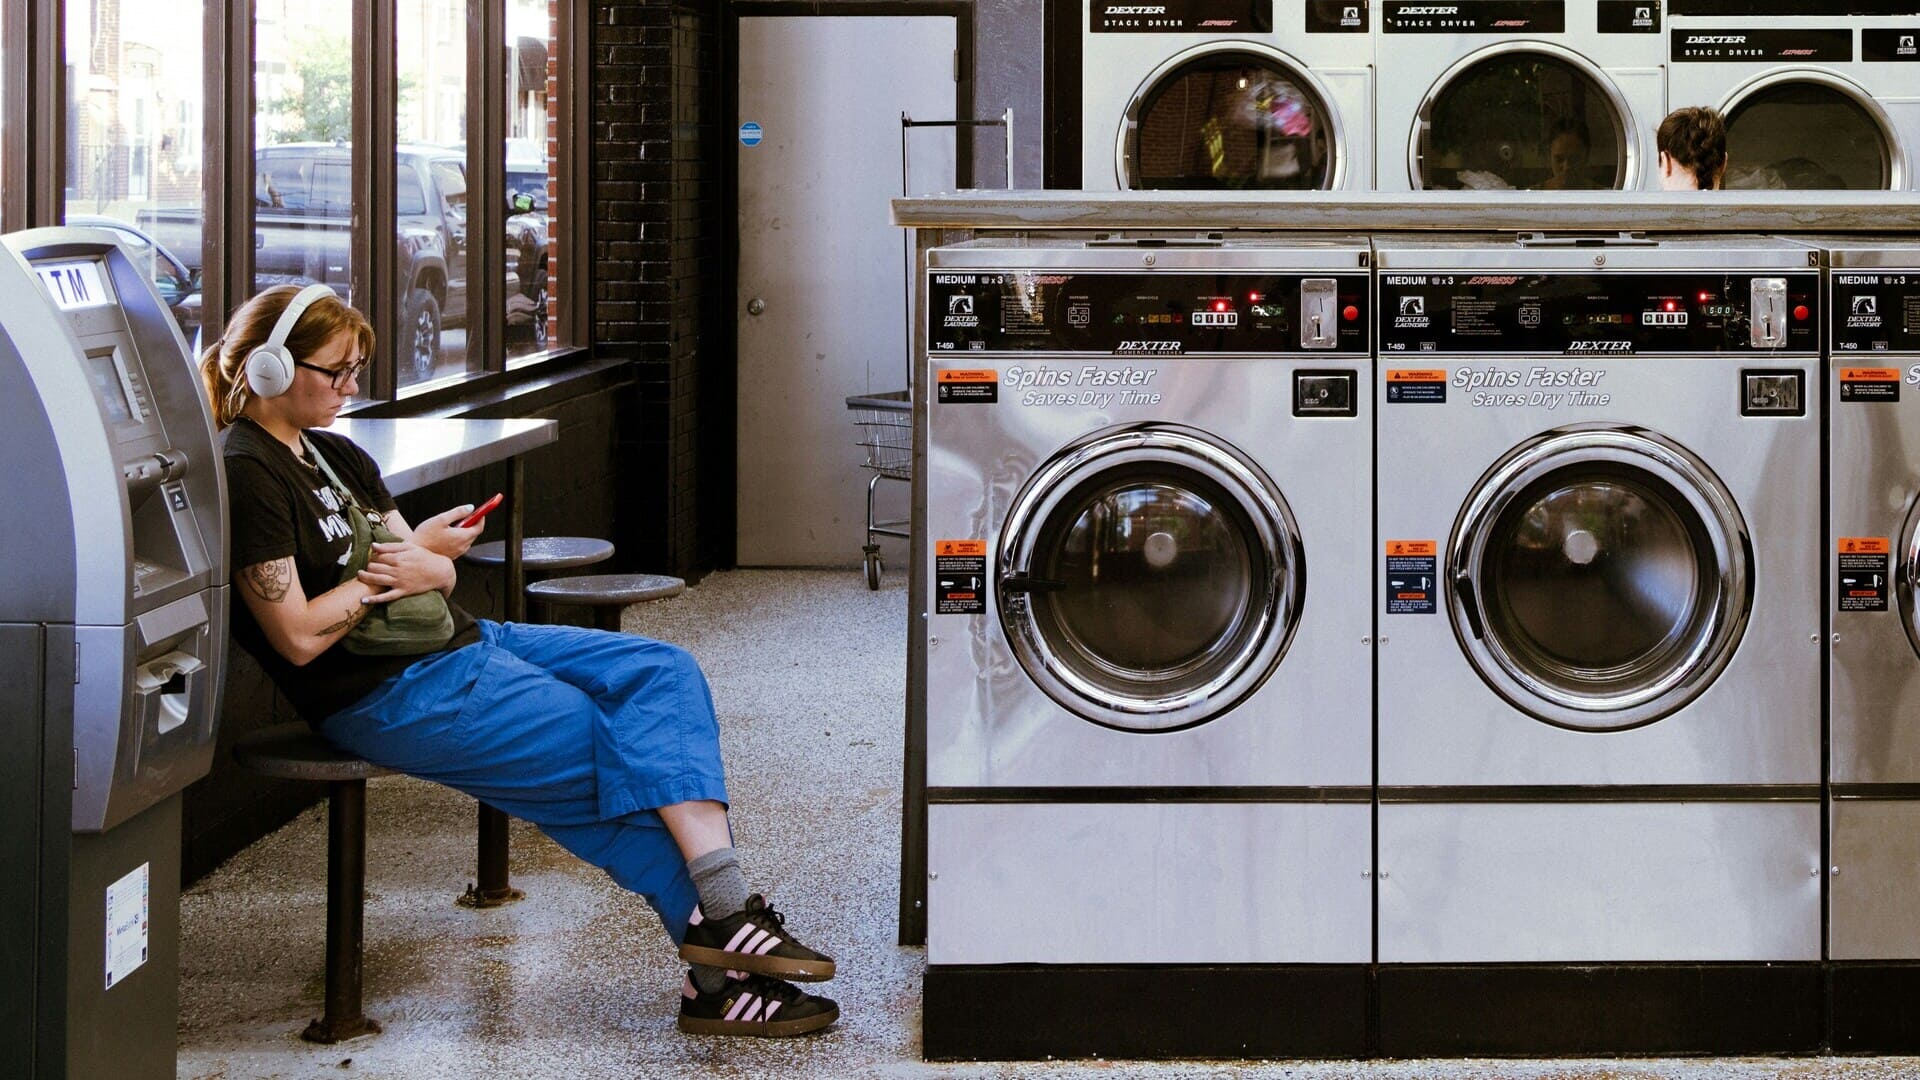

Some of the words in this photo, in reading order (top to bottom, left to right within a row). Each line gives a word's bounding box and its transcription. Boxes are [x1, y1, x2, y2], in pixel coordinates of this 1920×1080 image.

[1104, 6, 1166, 15] DEXTER
[1397, 6, 1459, 15] DEXTER
[1104, 20, 1140, 28] STACK
[1148, 20, 1184, 28] DRYER
[1396, 20, 1433, 28] STACK
[1440, 20, 1476, 28] DRYER
[1685, 35, 1747, 44] DEXTER
[1361, 253, 1368, 266] 7
[1809, 252, 1817, 266] 8
[936, 275, 976, 285] MEDIUM
[997, 275, 1004, 285] 3
[1386, 276, 1427, 285] MEDIUM
[1448, 276, 1454, 285] 3
[1467, 276, 1518, 285] EXPRESS
[1839, 276, 1879, 285] MEDIUM
[1899, 276, 1906, 285] 3
[37, 267, 90, 304] TM
[1117, 340, 1182, 351] DEXTER
[1386, 342, 1406, 350] T-450
[1567, 340, 1632, 351] DEXTER
[1839, 342, 1858, 350] T-450
[1003, 366, 1072, 391] Spins
[1075, 365, 1158, 386] Faster
[1452, 366, 1522, 392] Spins
[1524, 366, 1606, 387] Faster
[1023, 390, 1077, 406] Saves
[1078, 390, 1114, 409] Dry
[1119, 390, 1161, 405] Time
[1471, 390, 1526, 407] Saves
[1527, 391, 1563, 410] Dry
[1567, 390, 1610, 406] Time
